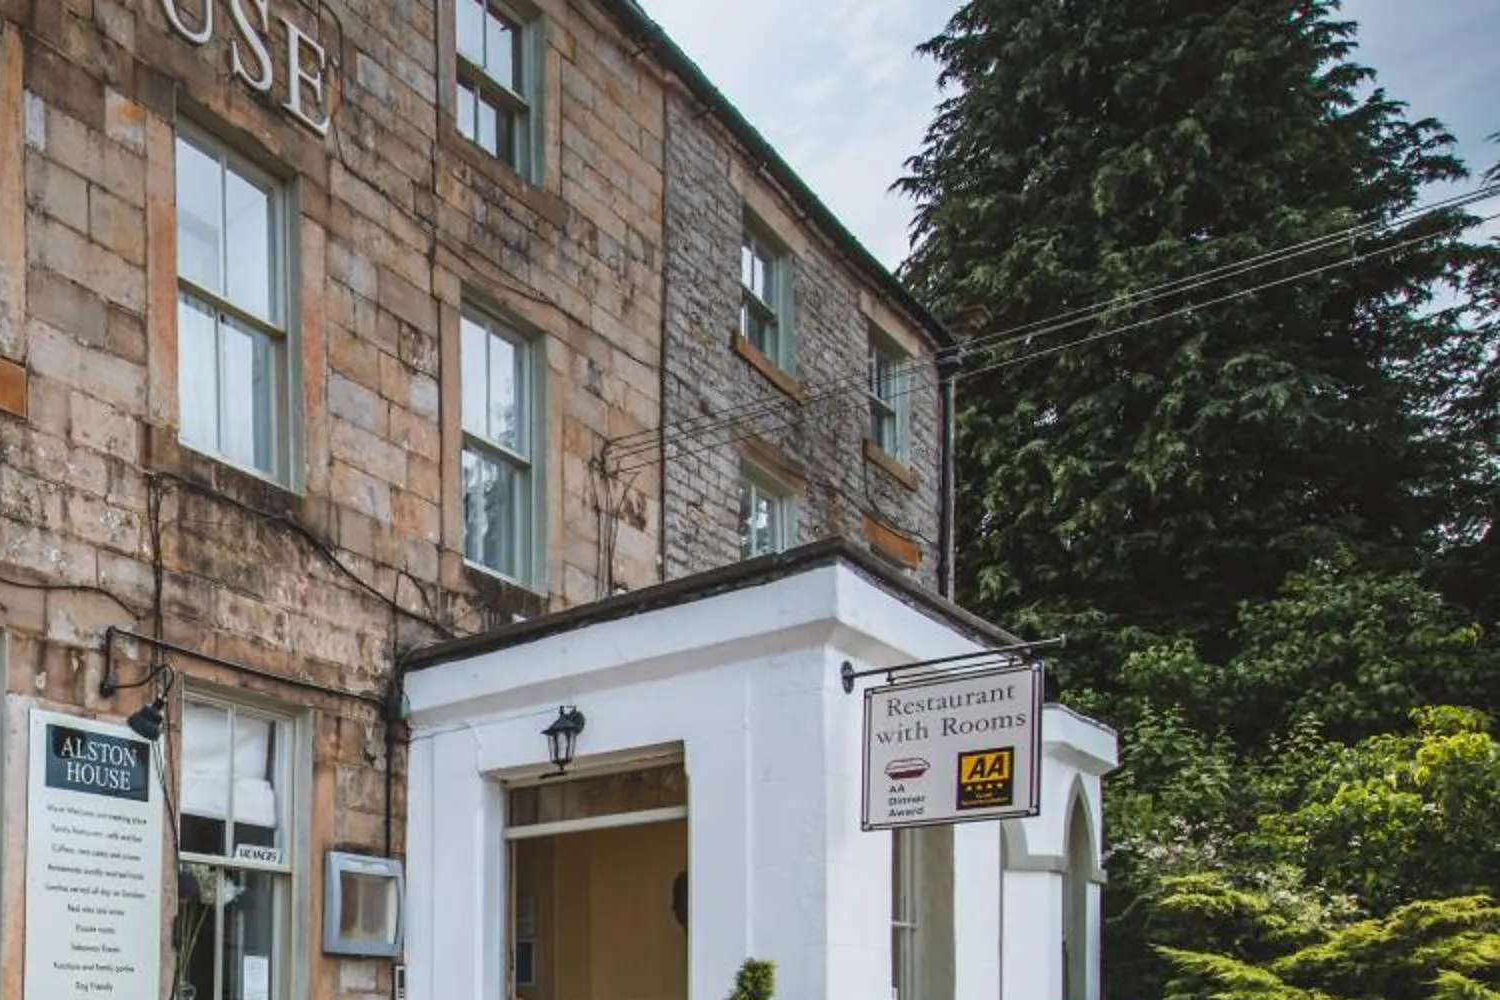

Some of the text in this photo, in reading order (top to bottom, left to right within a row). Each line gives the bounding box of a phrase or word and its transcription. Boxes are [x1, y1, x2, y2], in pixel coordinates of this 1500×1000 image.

[886, 684, 1016, 717] Restaurant
[876, 712, 1027, 745] with Rooms
[61, 736, 137, 768] ALSTON
[67, 761, 131, 791] HOUSE
[967, 754, 1004, 781] AA
[888, 795, 926, 806] Dinner
[889, 784, 905, 793] AA
[888, 807, 925, 818] Award
